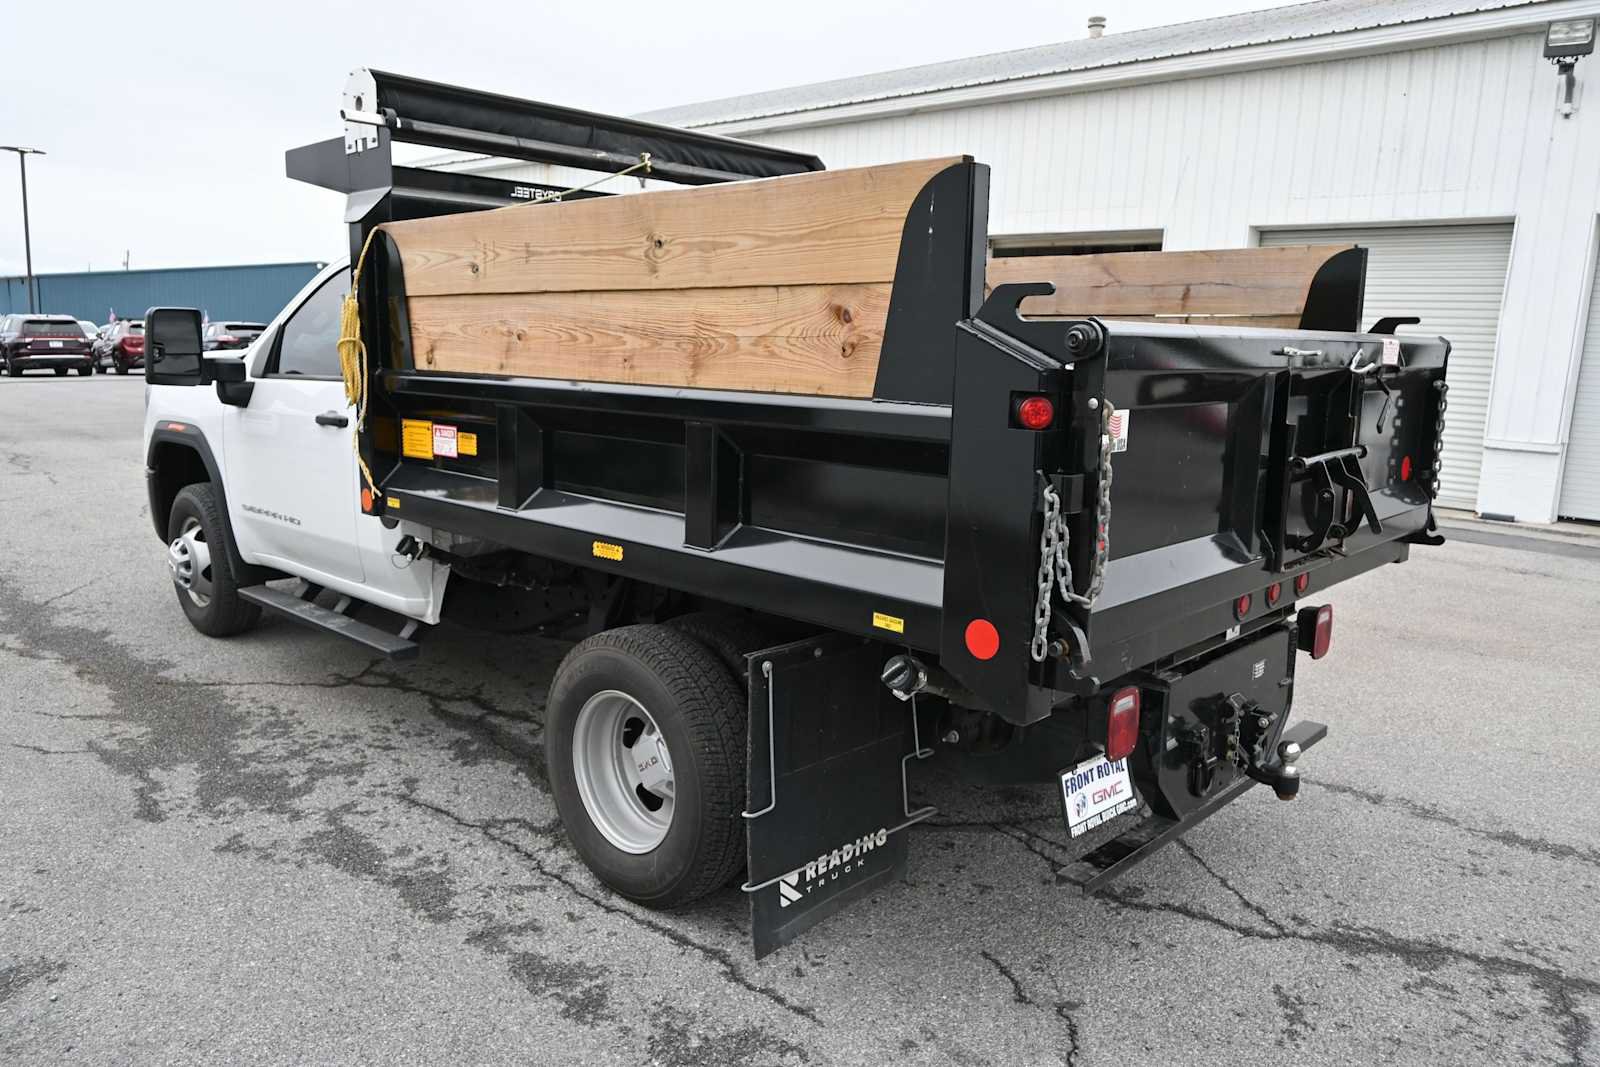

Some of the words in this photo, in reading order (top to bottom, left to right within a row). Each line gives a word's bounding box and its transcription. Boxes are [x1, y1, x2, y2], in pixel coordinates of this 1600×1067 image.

[1064, 767, 1094, 798] FRONT
[1096, 759, 1125, 780] ROYAL
[1092, 780, 1124, 805] GMC
[805, 828, 887, 882] READING
[806, 859, 864, 893] TRUCK
